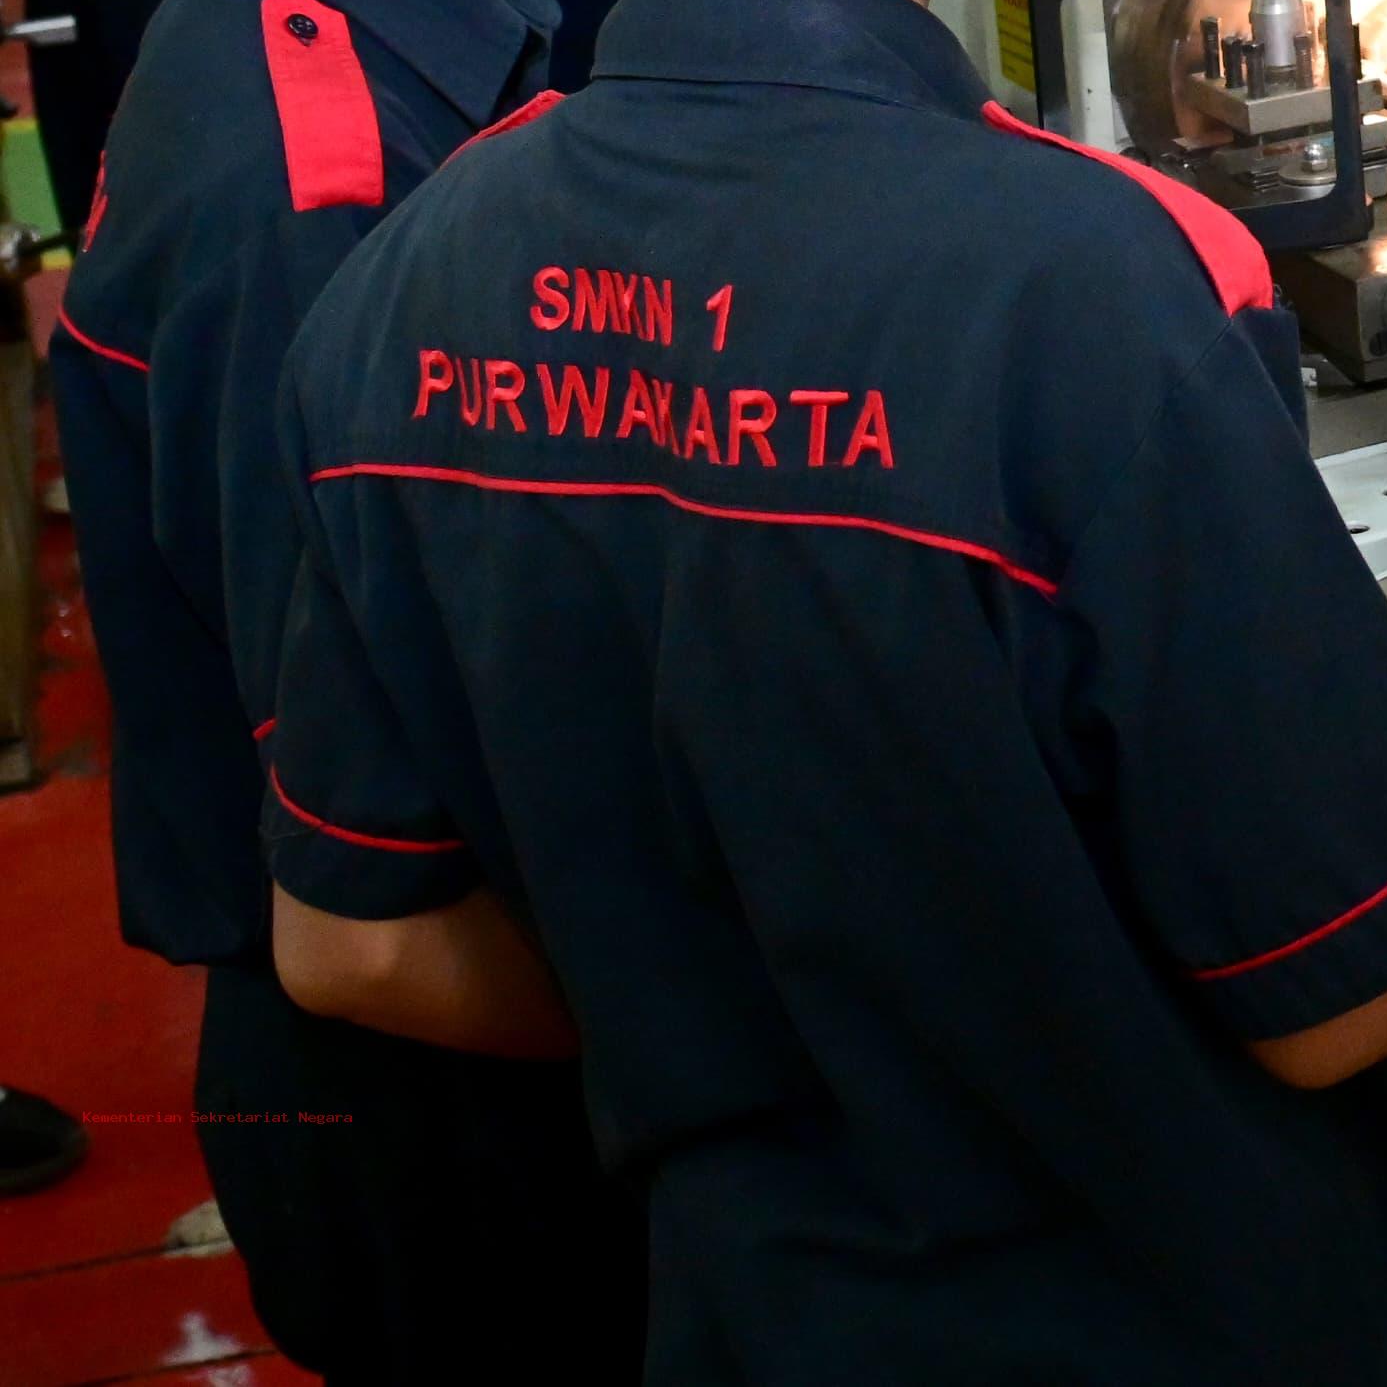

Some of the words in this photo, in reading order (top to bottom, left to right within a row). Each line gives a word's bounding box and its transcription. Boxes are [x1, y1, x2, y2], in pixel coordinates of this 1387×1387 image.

[530, 266, 673, 346] SMKN
[706, 284, 733, 352] 1
[412, 348, 894, 469] PURWAKARTA
